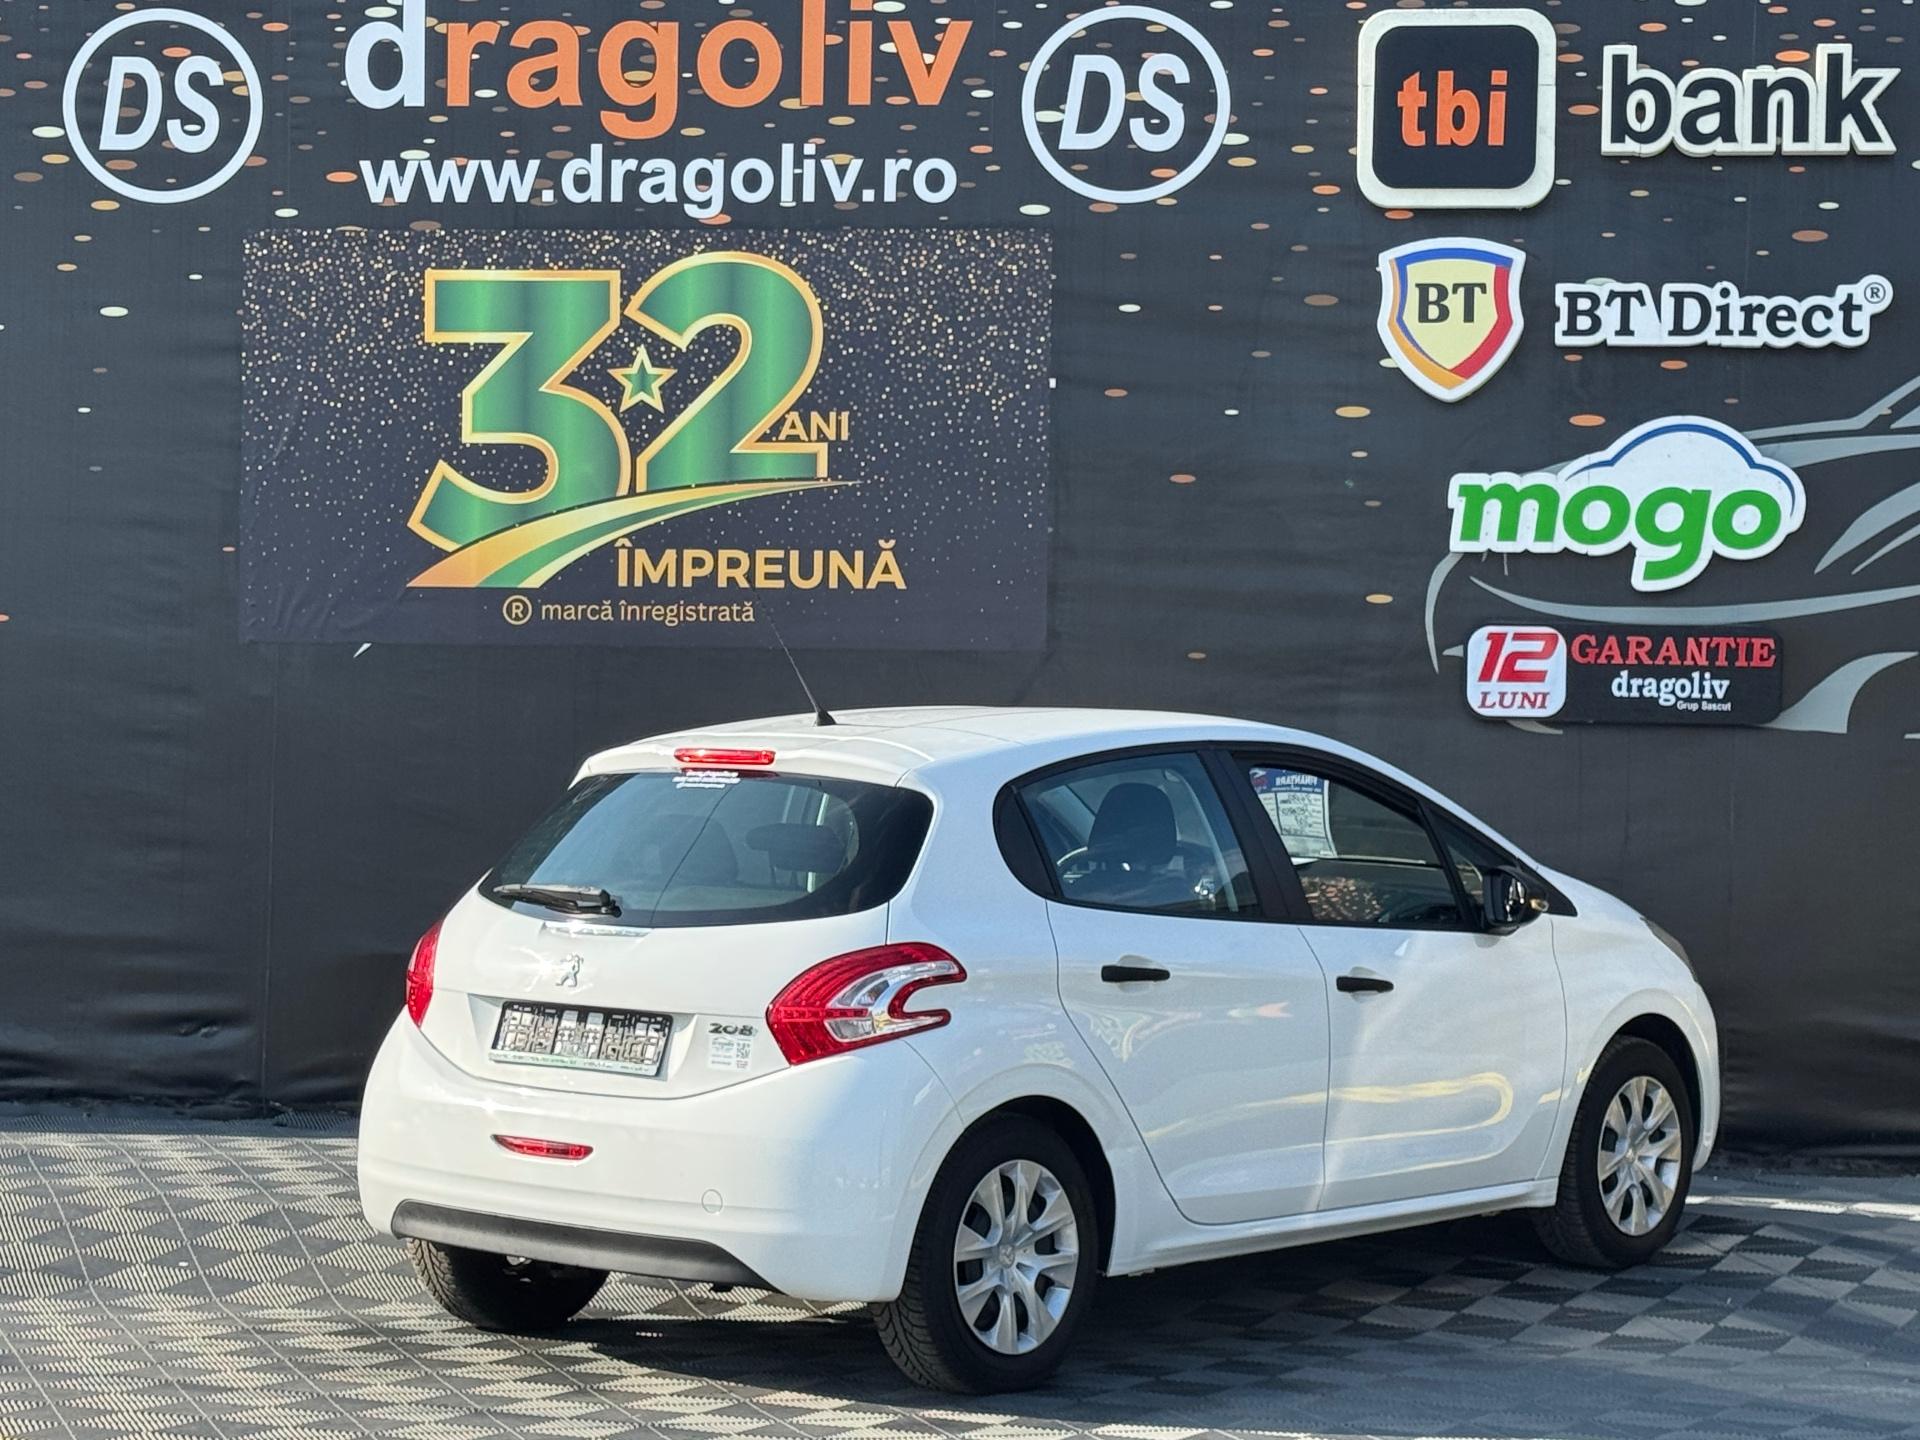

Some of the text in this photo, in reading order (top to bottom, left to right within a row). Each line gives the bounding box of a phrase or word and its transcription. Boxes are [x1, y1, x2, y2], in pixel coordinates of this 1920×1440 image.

[344, 0, 973, 140] dragoliv
[100, 55, 225, 153] DS
[1057, 53, 1192, 152] DS
[1397, 49, 1896, 148] tbi bank
[358, 143, 958, 220] www.dragoliv.ro
[1415, 282, 1487, 323] BT
[1561, 289, 1647, 337] BT
[778, 410, 851, 441] ANI
[1457, 483, 1782, 581] mogo
[613, 536, 908, 590] ÎMPREUNĂ
[540, 600, 614, 622] marcă
[619, 600, 756, 628] înregistrată
[1477, 632, 1559, 683] 12
[1570, 634, 1777, 669] GARANTIE
[1478, 690, 1550, 710] LUNI
[1611, 670, 1731, 707] dragoliv
[1676, 700, 1700, 713] Grup
[708, 1022, 754, 1037] 208
